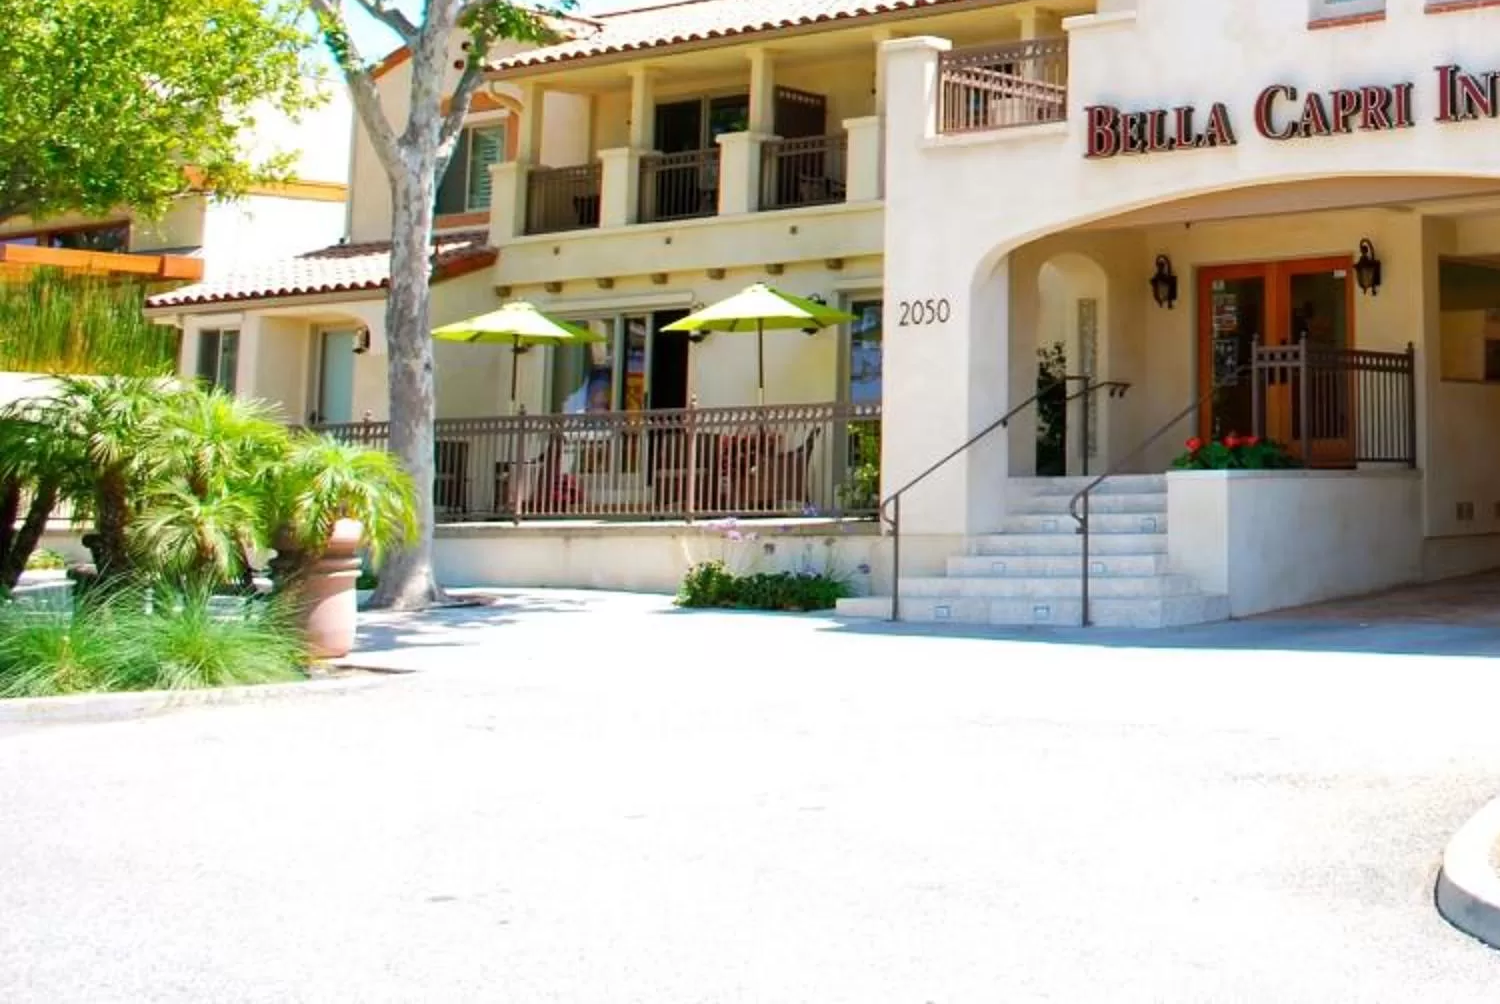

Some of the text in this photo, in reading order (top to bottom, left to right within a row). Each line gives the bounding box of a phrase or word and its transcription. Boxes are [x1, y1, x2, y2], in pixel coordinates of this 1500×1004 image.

[1083, 102, 1237, 159] BELLA
[1253, 82, 1416, 141] CAPRI
[899, 298, 951, 327] 2050
